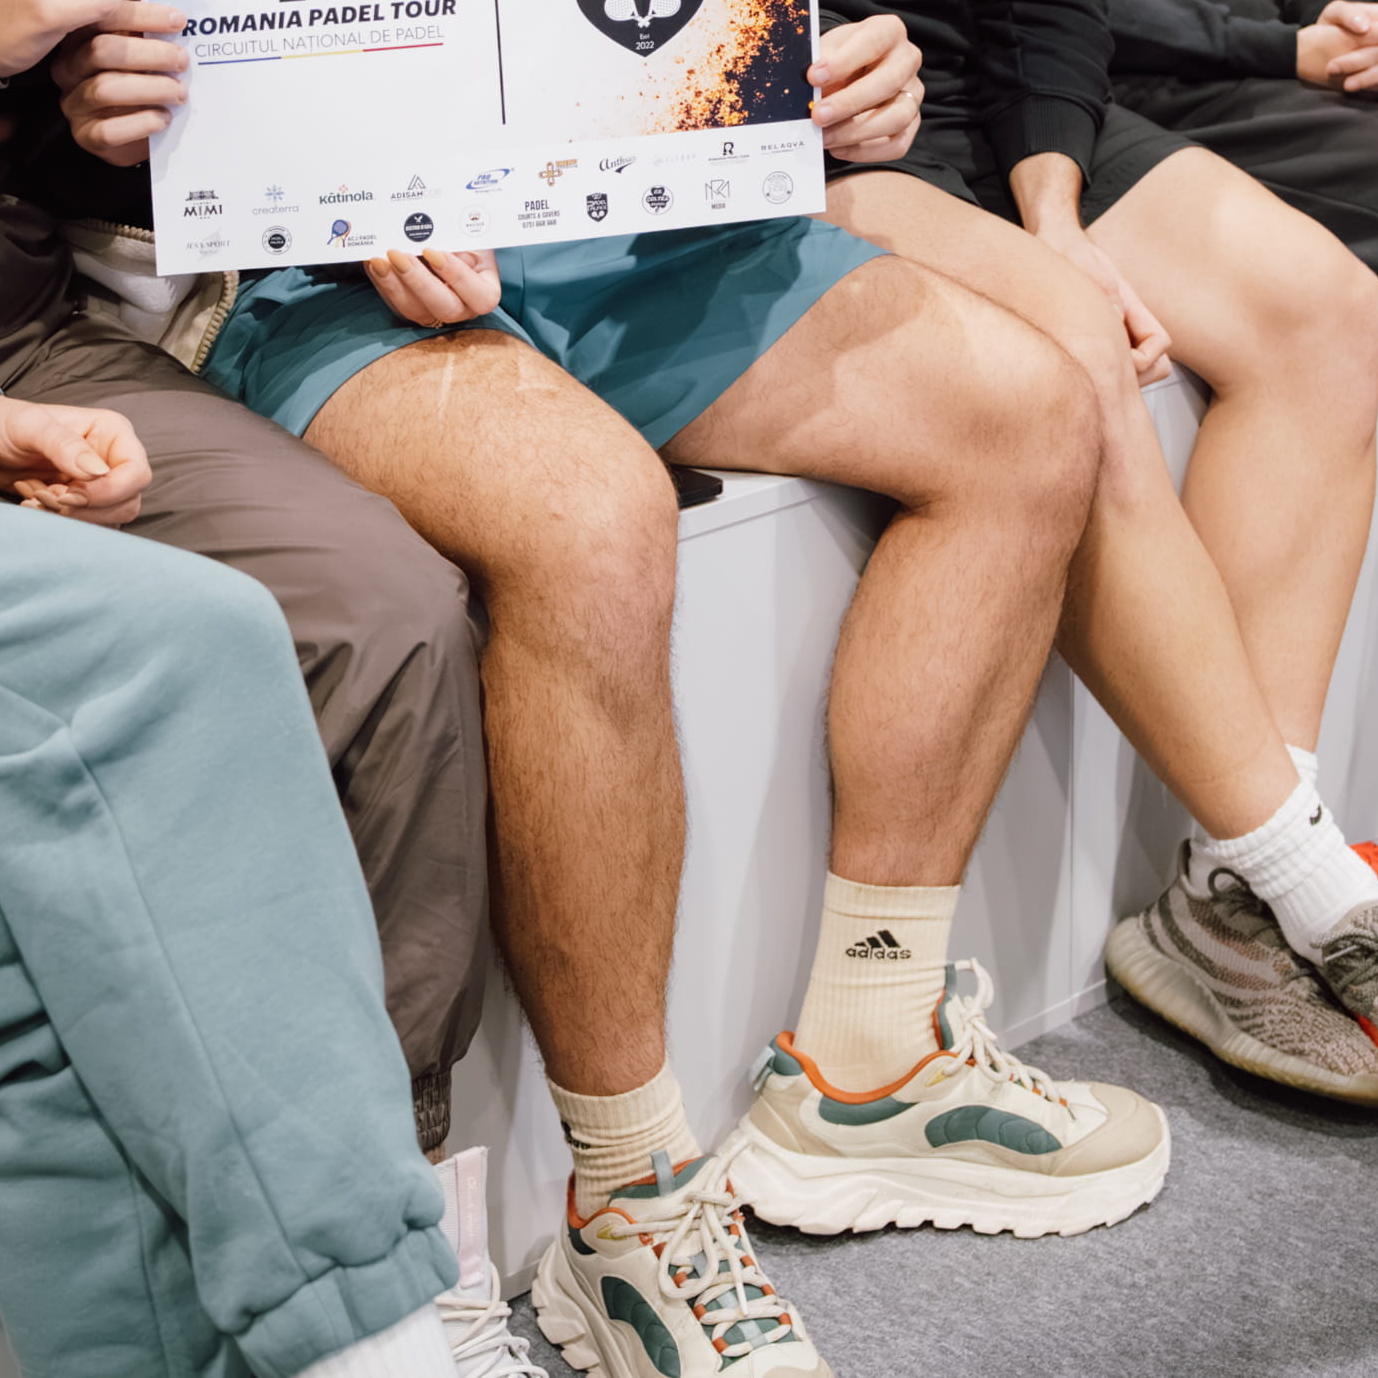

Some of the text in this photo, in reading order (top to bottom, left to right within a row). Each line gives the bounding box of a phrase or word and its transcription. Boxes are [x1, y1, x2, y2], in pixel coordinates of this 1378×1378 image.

[181, 10, 303, 37] ROMANIA
[308, 4, 385, 27] PADEL
[194, 39, 279, 58] CIRCUITUL
[370, 29, 391, 44] DE
[396, 25, 445, 40] PADEL
[635, 41, 655, 50] 2022
[183, 204, 223, 218] MIMI
[252, 205, 299, 215] createrra
[524, 199, 550, 211] PADEL
[845, 947, 912, 960] adidas
